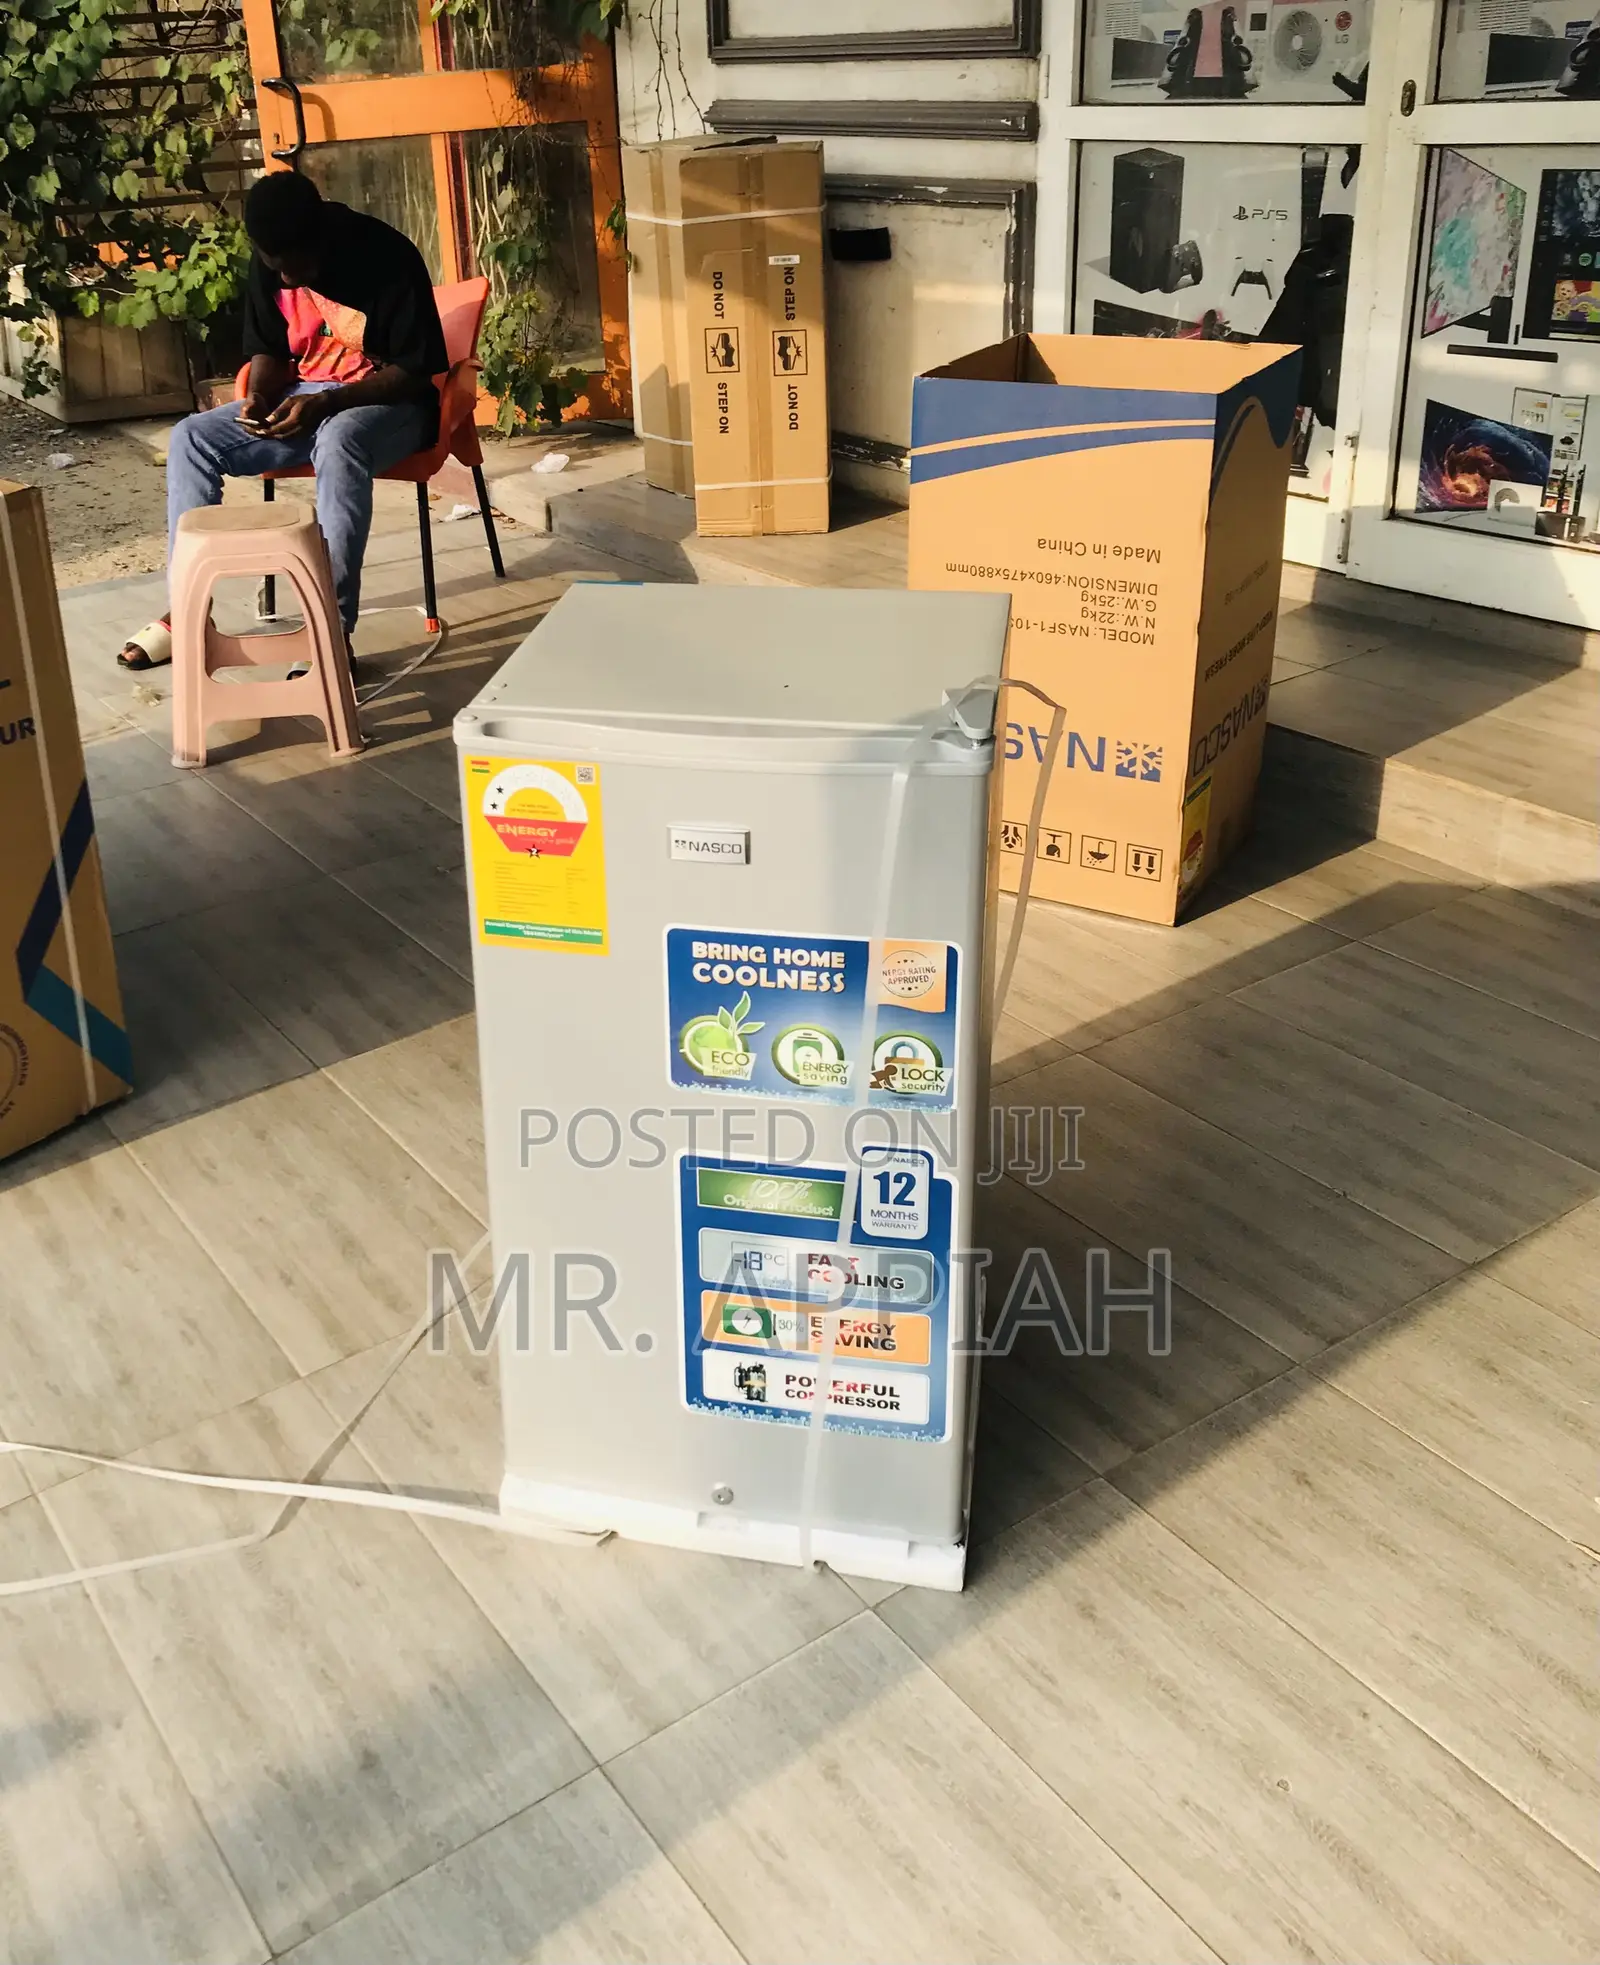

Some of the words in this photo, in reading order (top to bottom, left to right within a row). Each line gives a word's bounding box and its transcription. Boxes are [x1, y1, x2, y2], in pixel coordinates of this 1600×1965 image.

[1335, 34, 1350, 44] LG
[1251, 208, 1288, 221] PS5
[712, 271, 723, 290] DO
[784, 266, 795, 286] ON
[713, 293, 725, 319] NOT
[784, 290, 796, 321] STEP
[717, 382, 729, 413] STEP
[787, 384, 799, 410] NOT
[719, 416, 730, 434] ON
[788, 412, 799, 430] DO
[1037, 538, 1088, 557] China
[1092, 543, 1108, 559] in
[1112, 544, 1162, 564] Made
[1094, 626, 1155, 646] MODEL:
[1192, 692, 1256, 778] NASCO
[496, 823, 558, 838] ENERGY
[530, 848, 538, 856] 2
[688, 840, 742, 854] NASCO
[692, 941, 767, 965] BRING
[773, 947, 846, 969] HOME
[692, 963, 846, 994] COOLNESS
[882, 969, 906, 977] NERGY
[908, 966, 937, 975] RATING
[887, 974, 930, 985] APPROVED
[711, 1050, 750, 1065] ECO
[711, 1064, 750, 1079] friendly
[802, 1060, 849, 1074] ENERGY
[901, 1068, 945, 1083] LOCK
[802, 1072, 848, 1086] saving
[901, 1081, 946, 1093] security
[750, 1178, 813, 1200] 100%
[873, 1171, 917, 1207] 12
[723, 1194, 779, 1212] Original
[782, 1201, 835, 1216] Product
[870, 1208, 919, 1221] MONTHS
[871, 1220, 919, 1231] WARRANTY
[808, 1253, 860, 1270] FAT
[778, 1318, 805, 1333] 30%
[810, 1316, 897, 1336] EERGY
[810, 1329, 897, 1351] SVING
[784, 1374, 901, 1398] POERFUL
